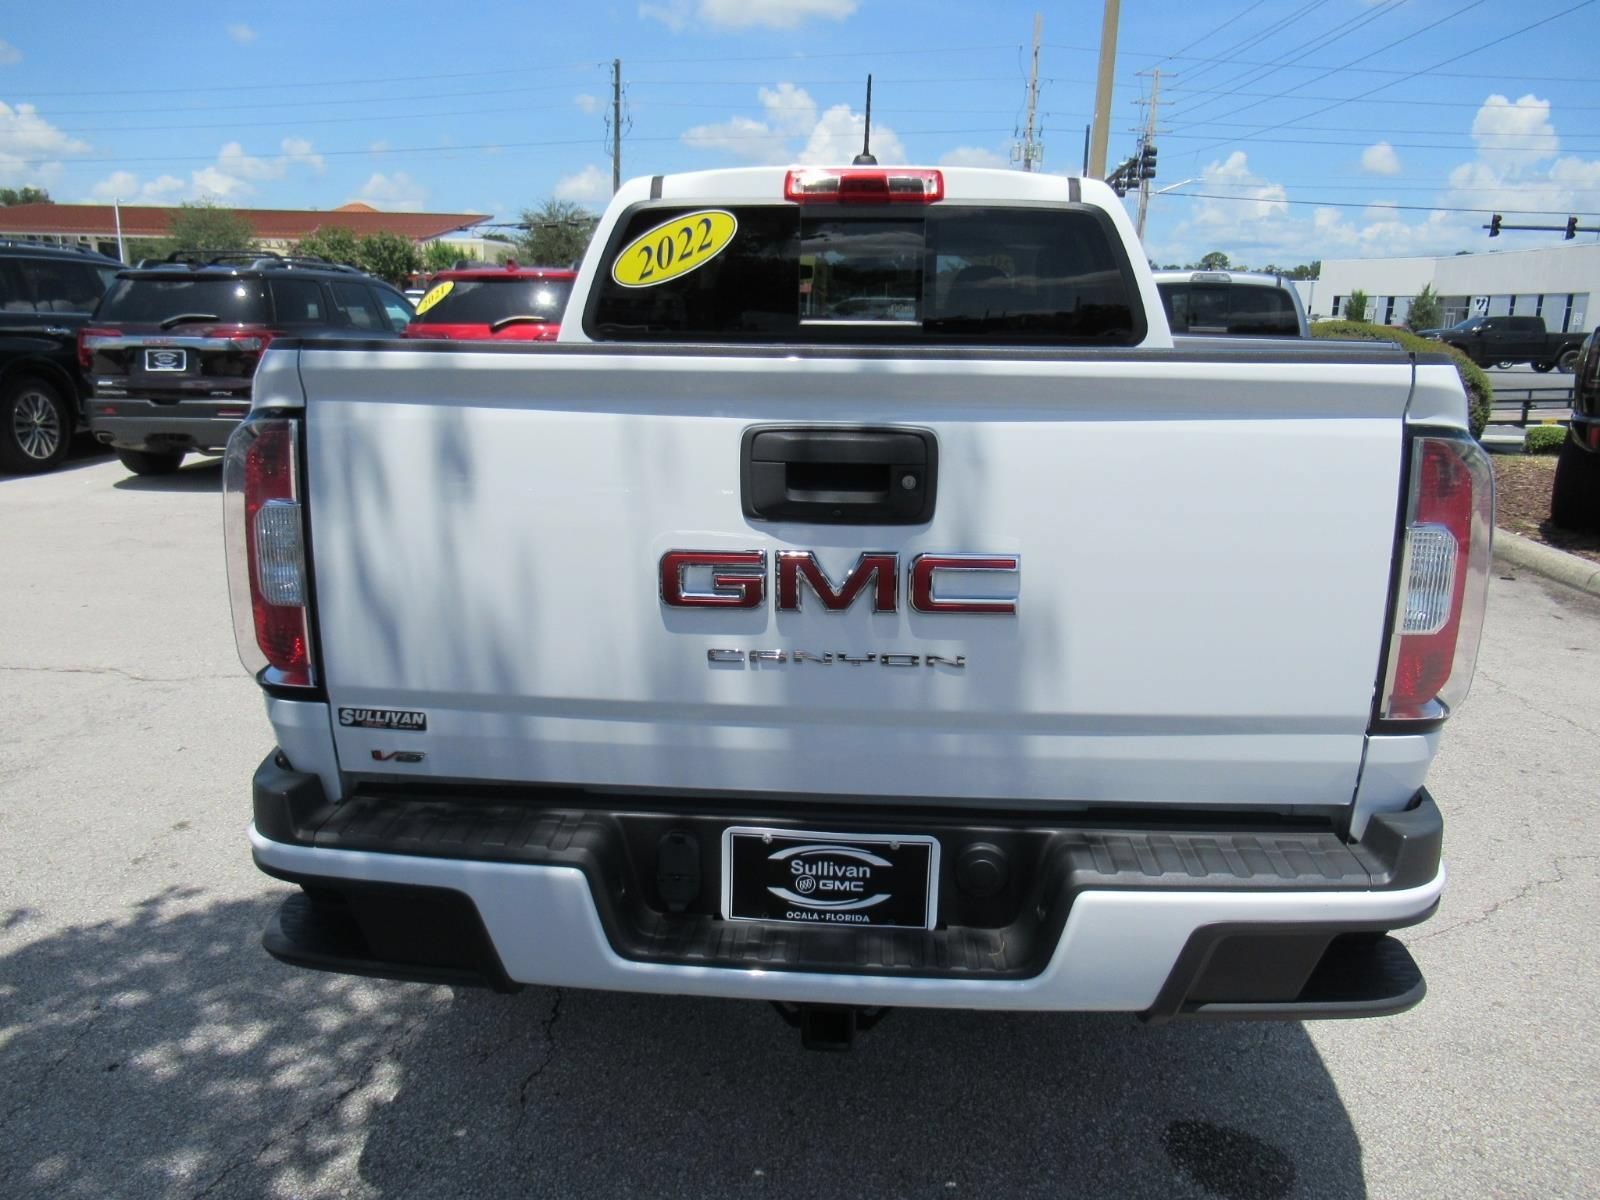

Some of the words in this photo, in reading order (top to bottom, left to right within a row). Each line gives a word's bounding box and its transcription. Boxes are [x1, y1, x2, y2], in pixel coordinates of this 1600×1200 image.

[637, 217, 713, 281] 2022
[659, 549, 1020, 615] GMC
[707, 648, 966, 667] CANYON
[341, 709, 425, 725] SULLIVAN
[791, 860, 870, 878] Sullivan
[819, 880, 864, 891] GMC
[786, 911, 819, 920] OCALA
[826, 912, 870, 922] FLORIDA
